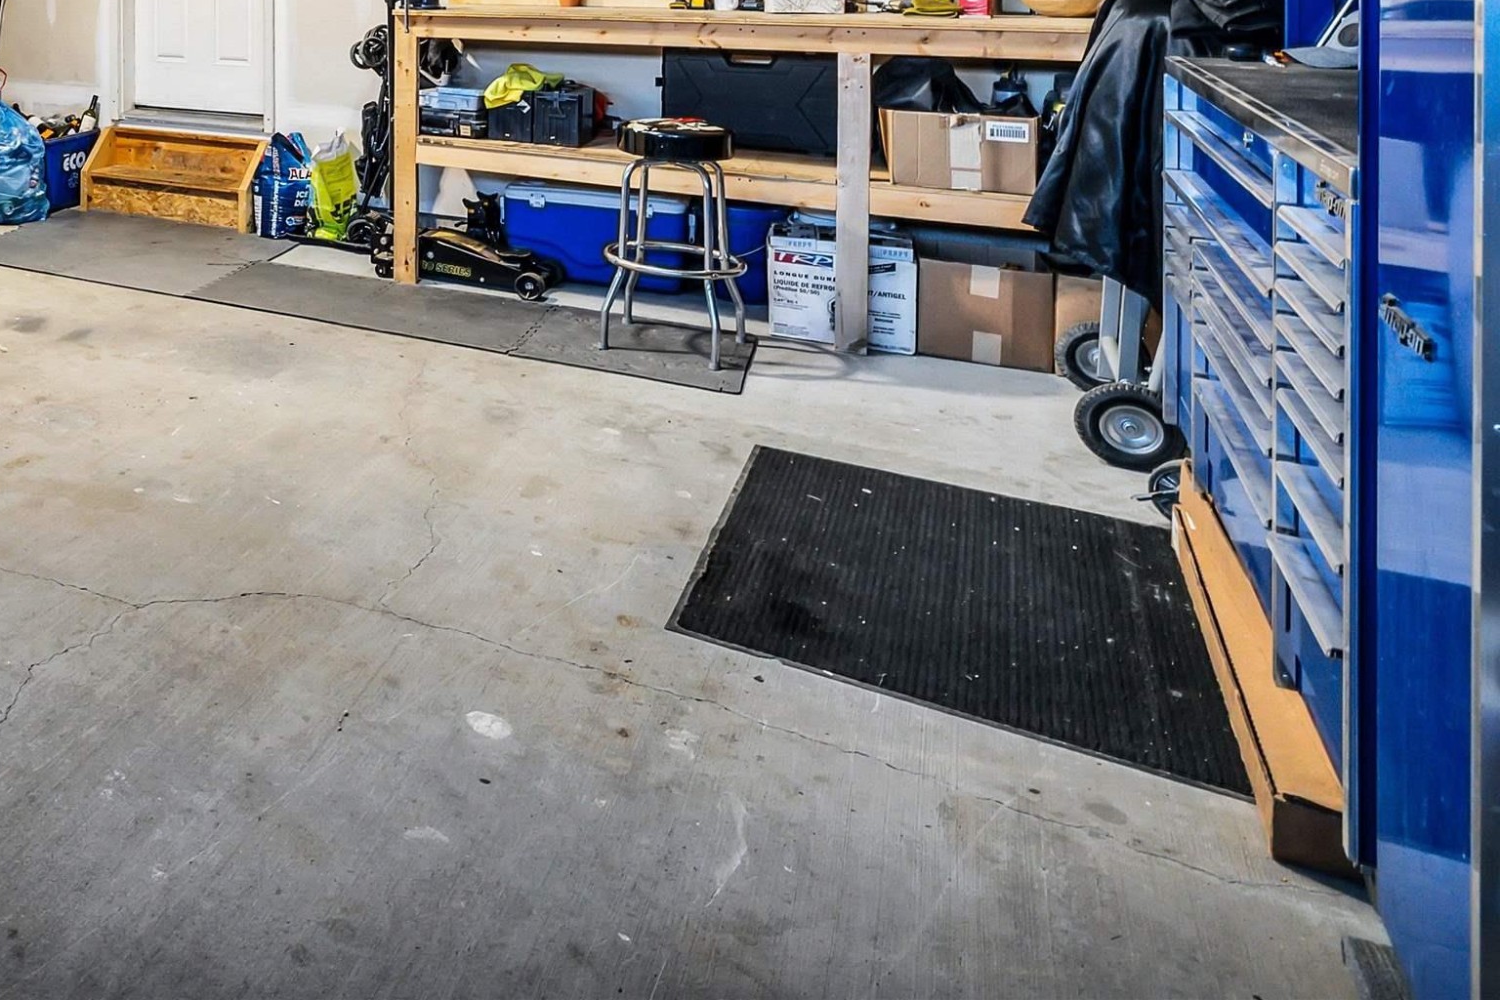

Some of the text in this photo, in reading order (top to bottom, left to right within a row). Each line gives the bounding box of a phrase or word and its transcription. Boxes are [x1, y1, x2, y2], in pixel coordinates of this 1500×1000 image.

[435, 262, 471, 278] SERIES
[773, 270, 809, 279] LONGUE
[773, 279, 799, 288] LIQUIDE
